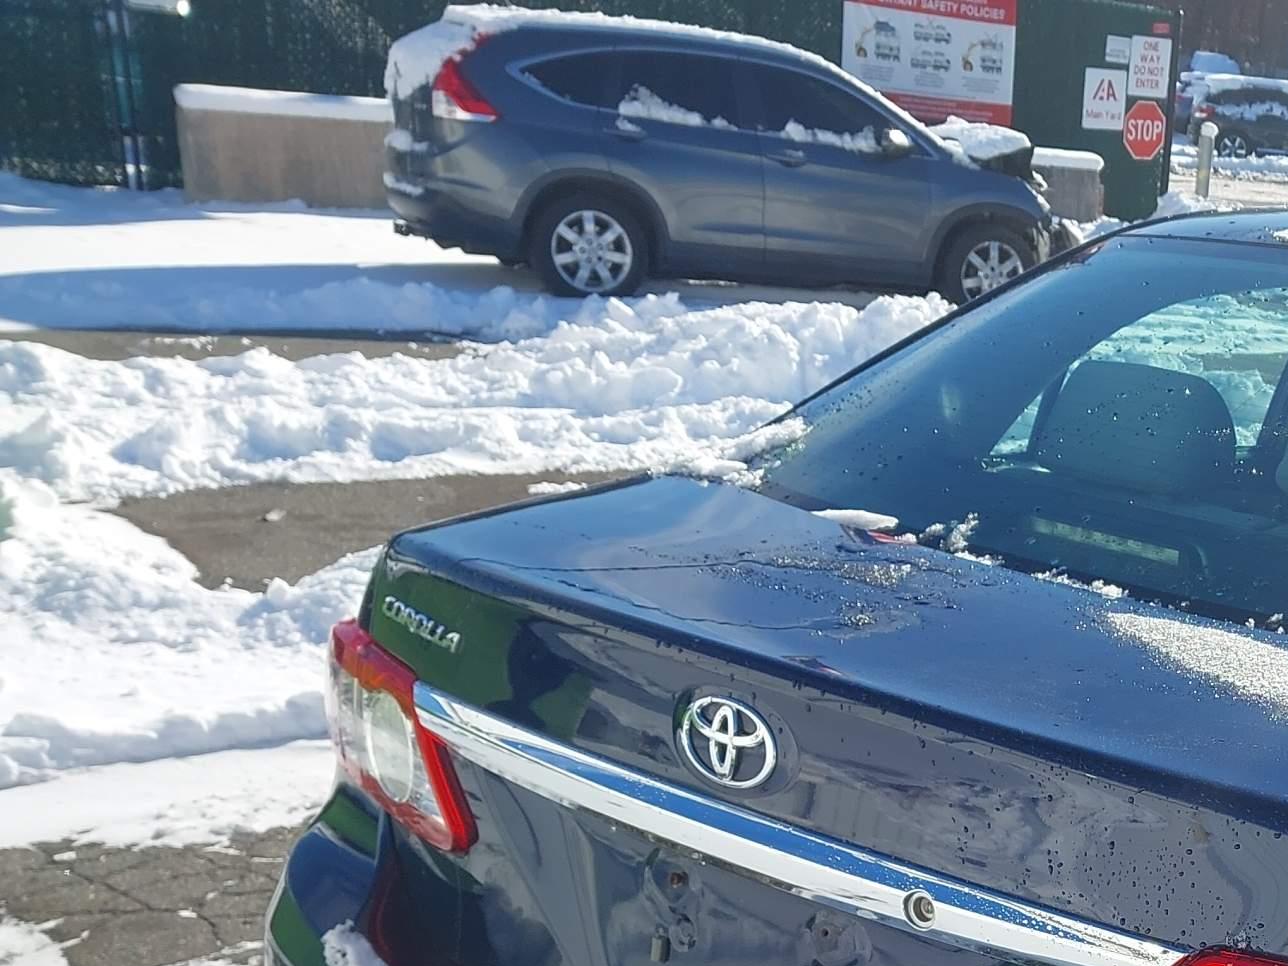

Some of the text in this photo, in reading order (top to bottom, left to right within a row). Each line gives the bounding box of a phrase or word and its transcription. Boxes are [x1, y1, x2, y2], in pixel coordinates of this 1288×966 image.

[921, 0, 958, 13] SAFETY
[960, 4, 1005, 19] POLICIES
[1143, 40, 1160, 52] ONE
[1140, 54, 1161, 63] WAY
[1133, 65, 1164, 77] DO NOT
[1135, 78, 1160, 89] ENTER
[1127, 119, 1162, 141] STOP
[382, 595, 461, 653] COROLLA
